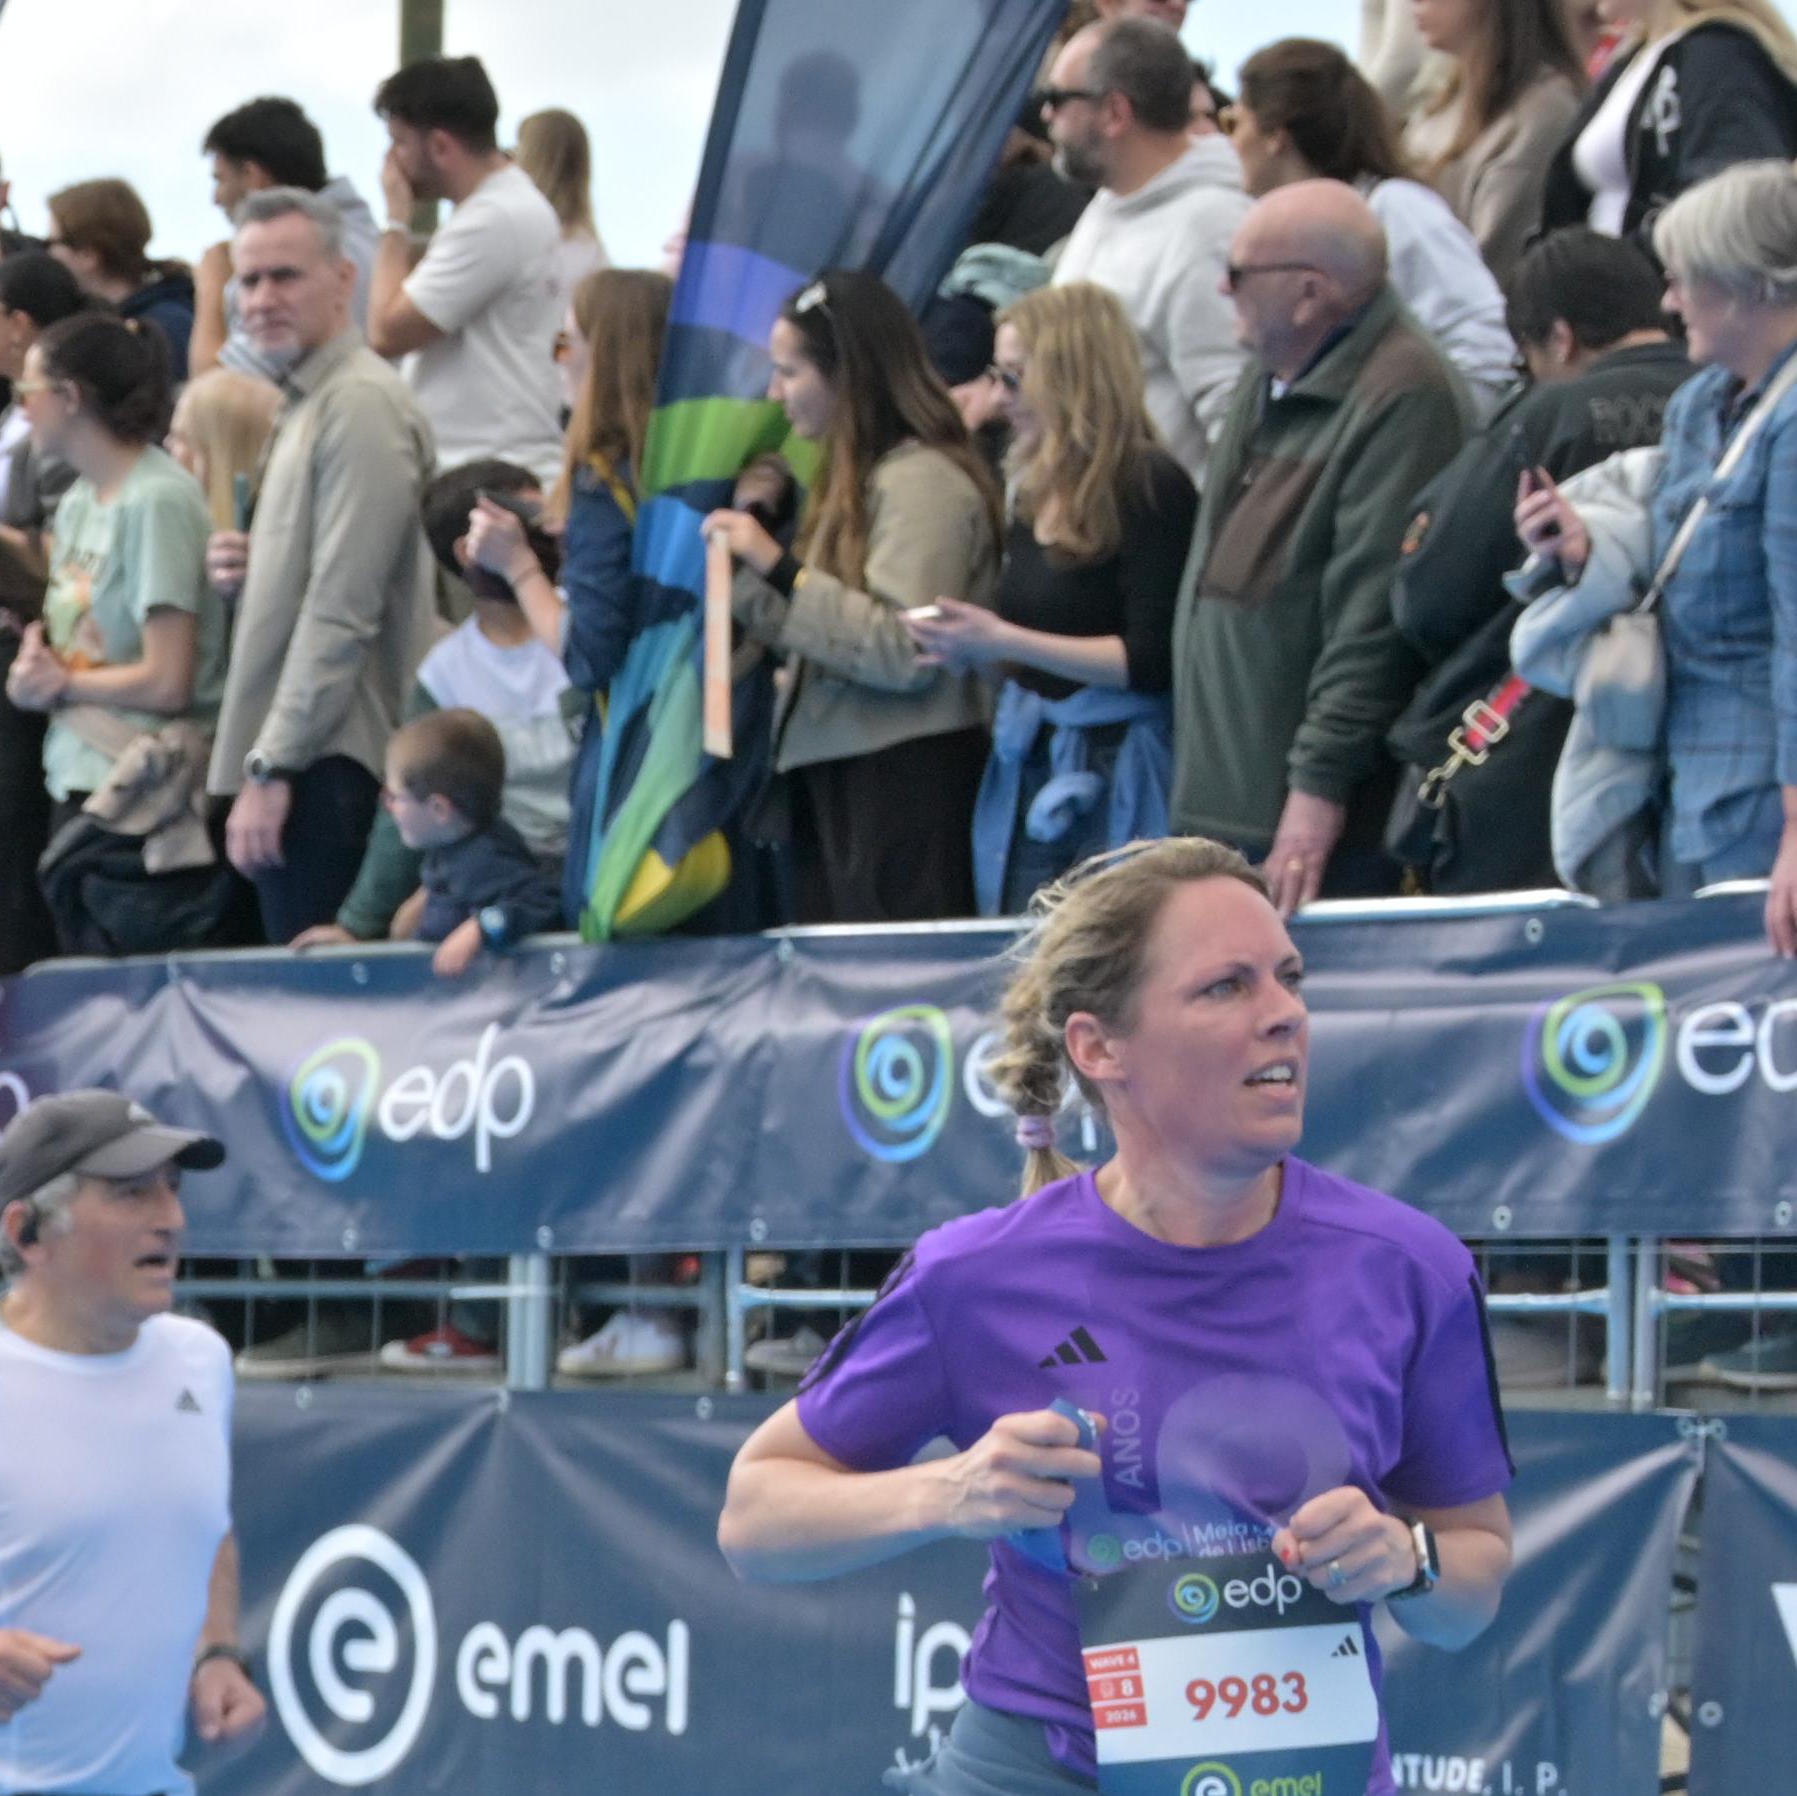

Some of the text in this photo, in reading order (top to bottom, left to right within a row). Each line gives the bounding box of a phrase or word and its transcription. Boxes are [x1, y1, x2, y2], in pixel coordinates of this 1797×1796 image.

[377, 1022, 536, 1173] edp
[1223, 1563, 1303, 1615] edp
[455, 1618, 690, 1736] emel
[1089, 1656, 1127, 1670] WAVE
[1120, 1679, 1134, 1697] 8
[1185, 1670, 1309, 1722] 9983
